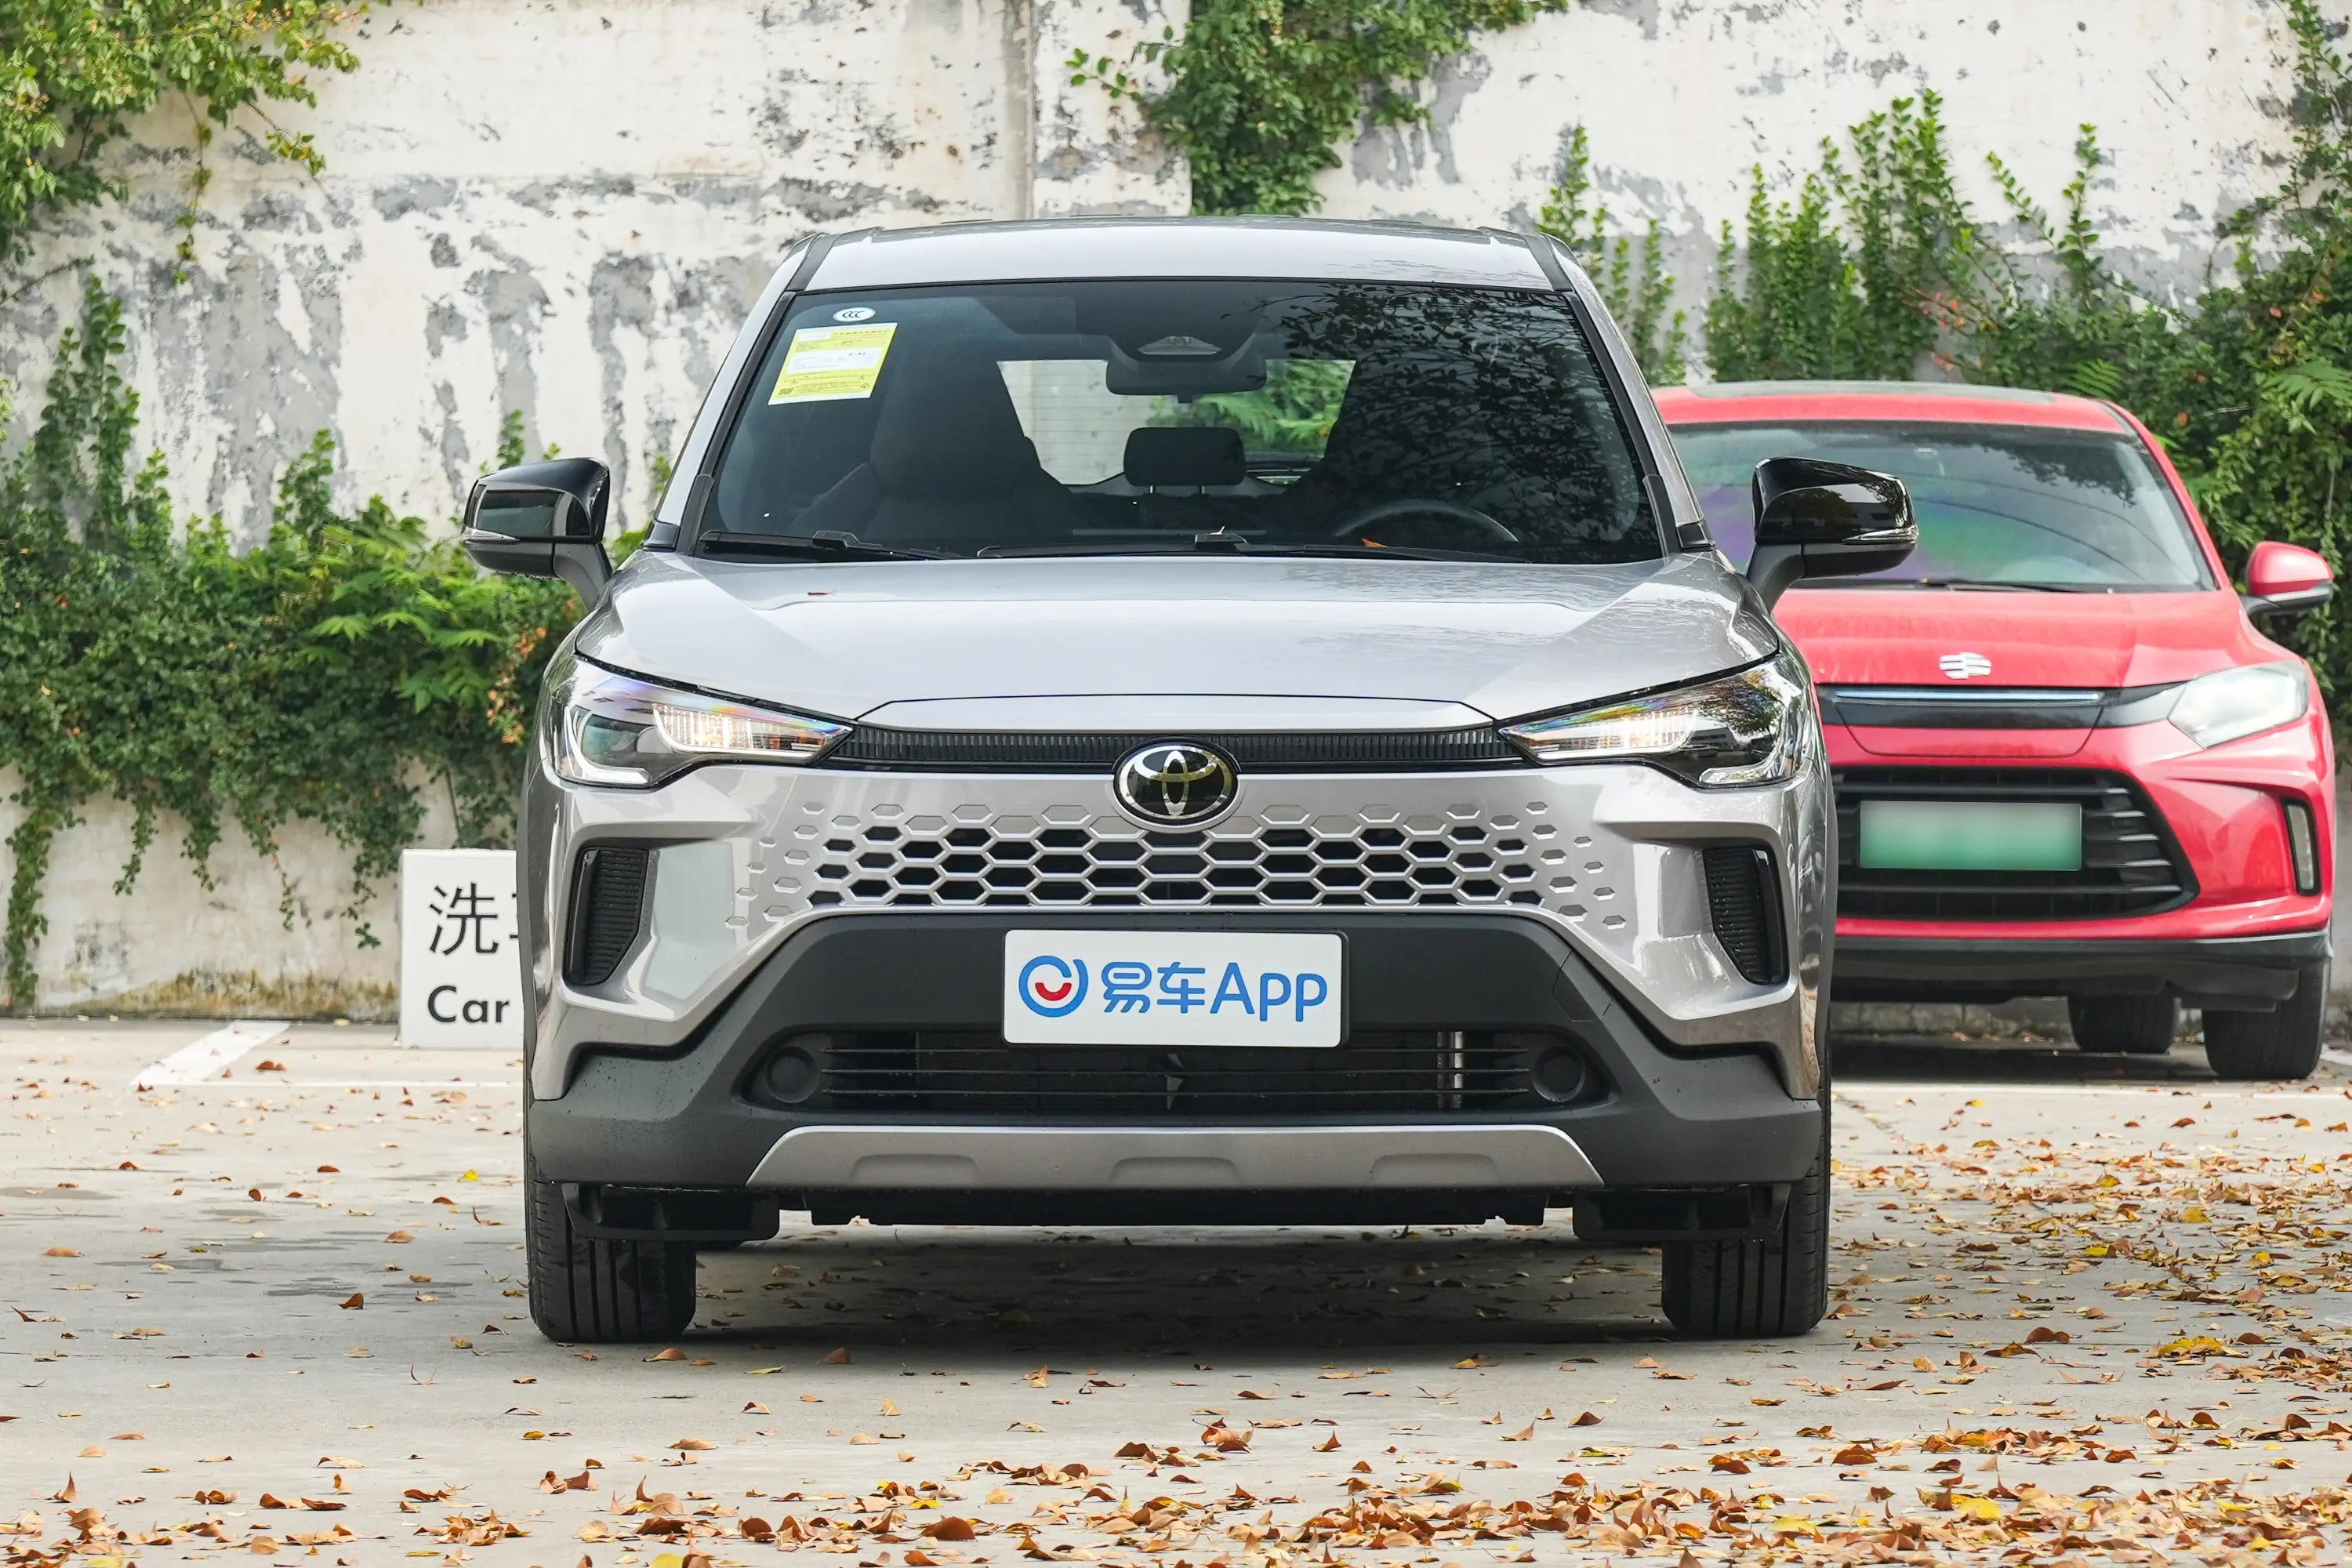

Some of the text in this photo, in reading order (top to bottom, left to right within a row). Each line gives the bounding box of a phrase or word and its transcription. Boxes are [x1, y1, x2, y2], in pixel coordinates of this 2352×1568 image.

[429, 882, 518, 956] 洗
[427, 985, 510, 1023] Car
[1101, 961, 1327, 1022] 易车App
